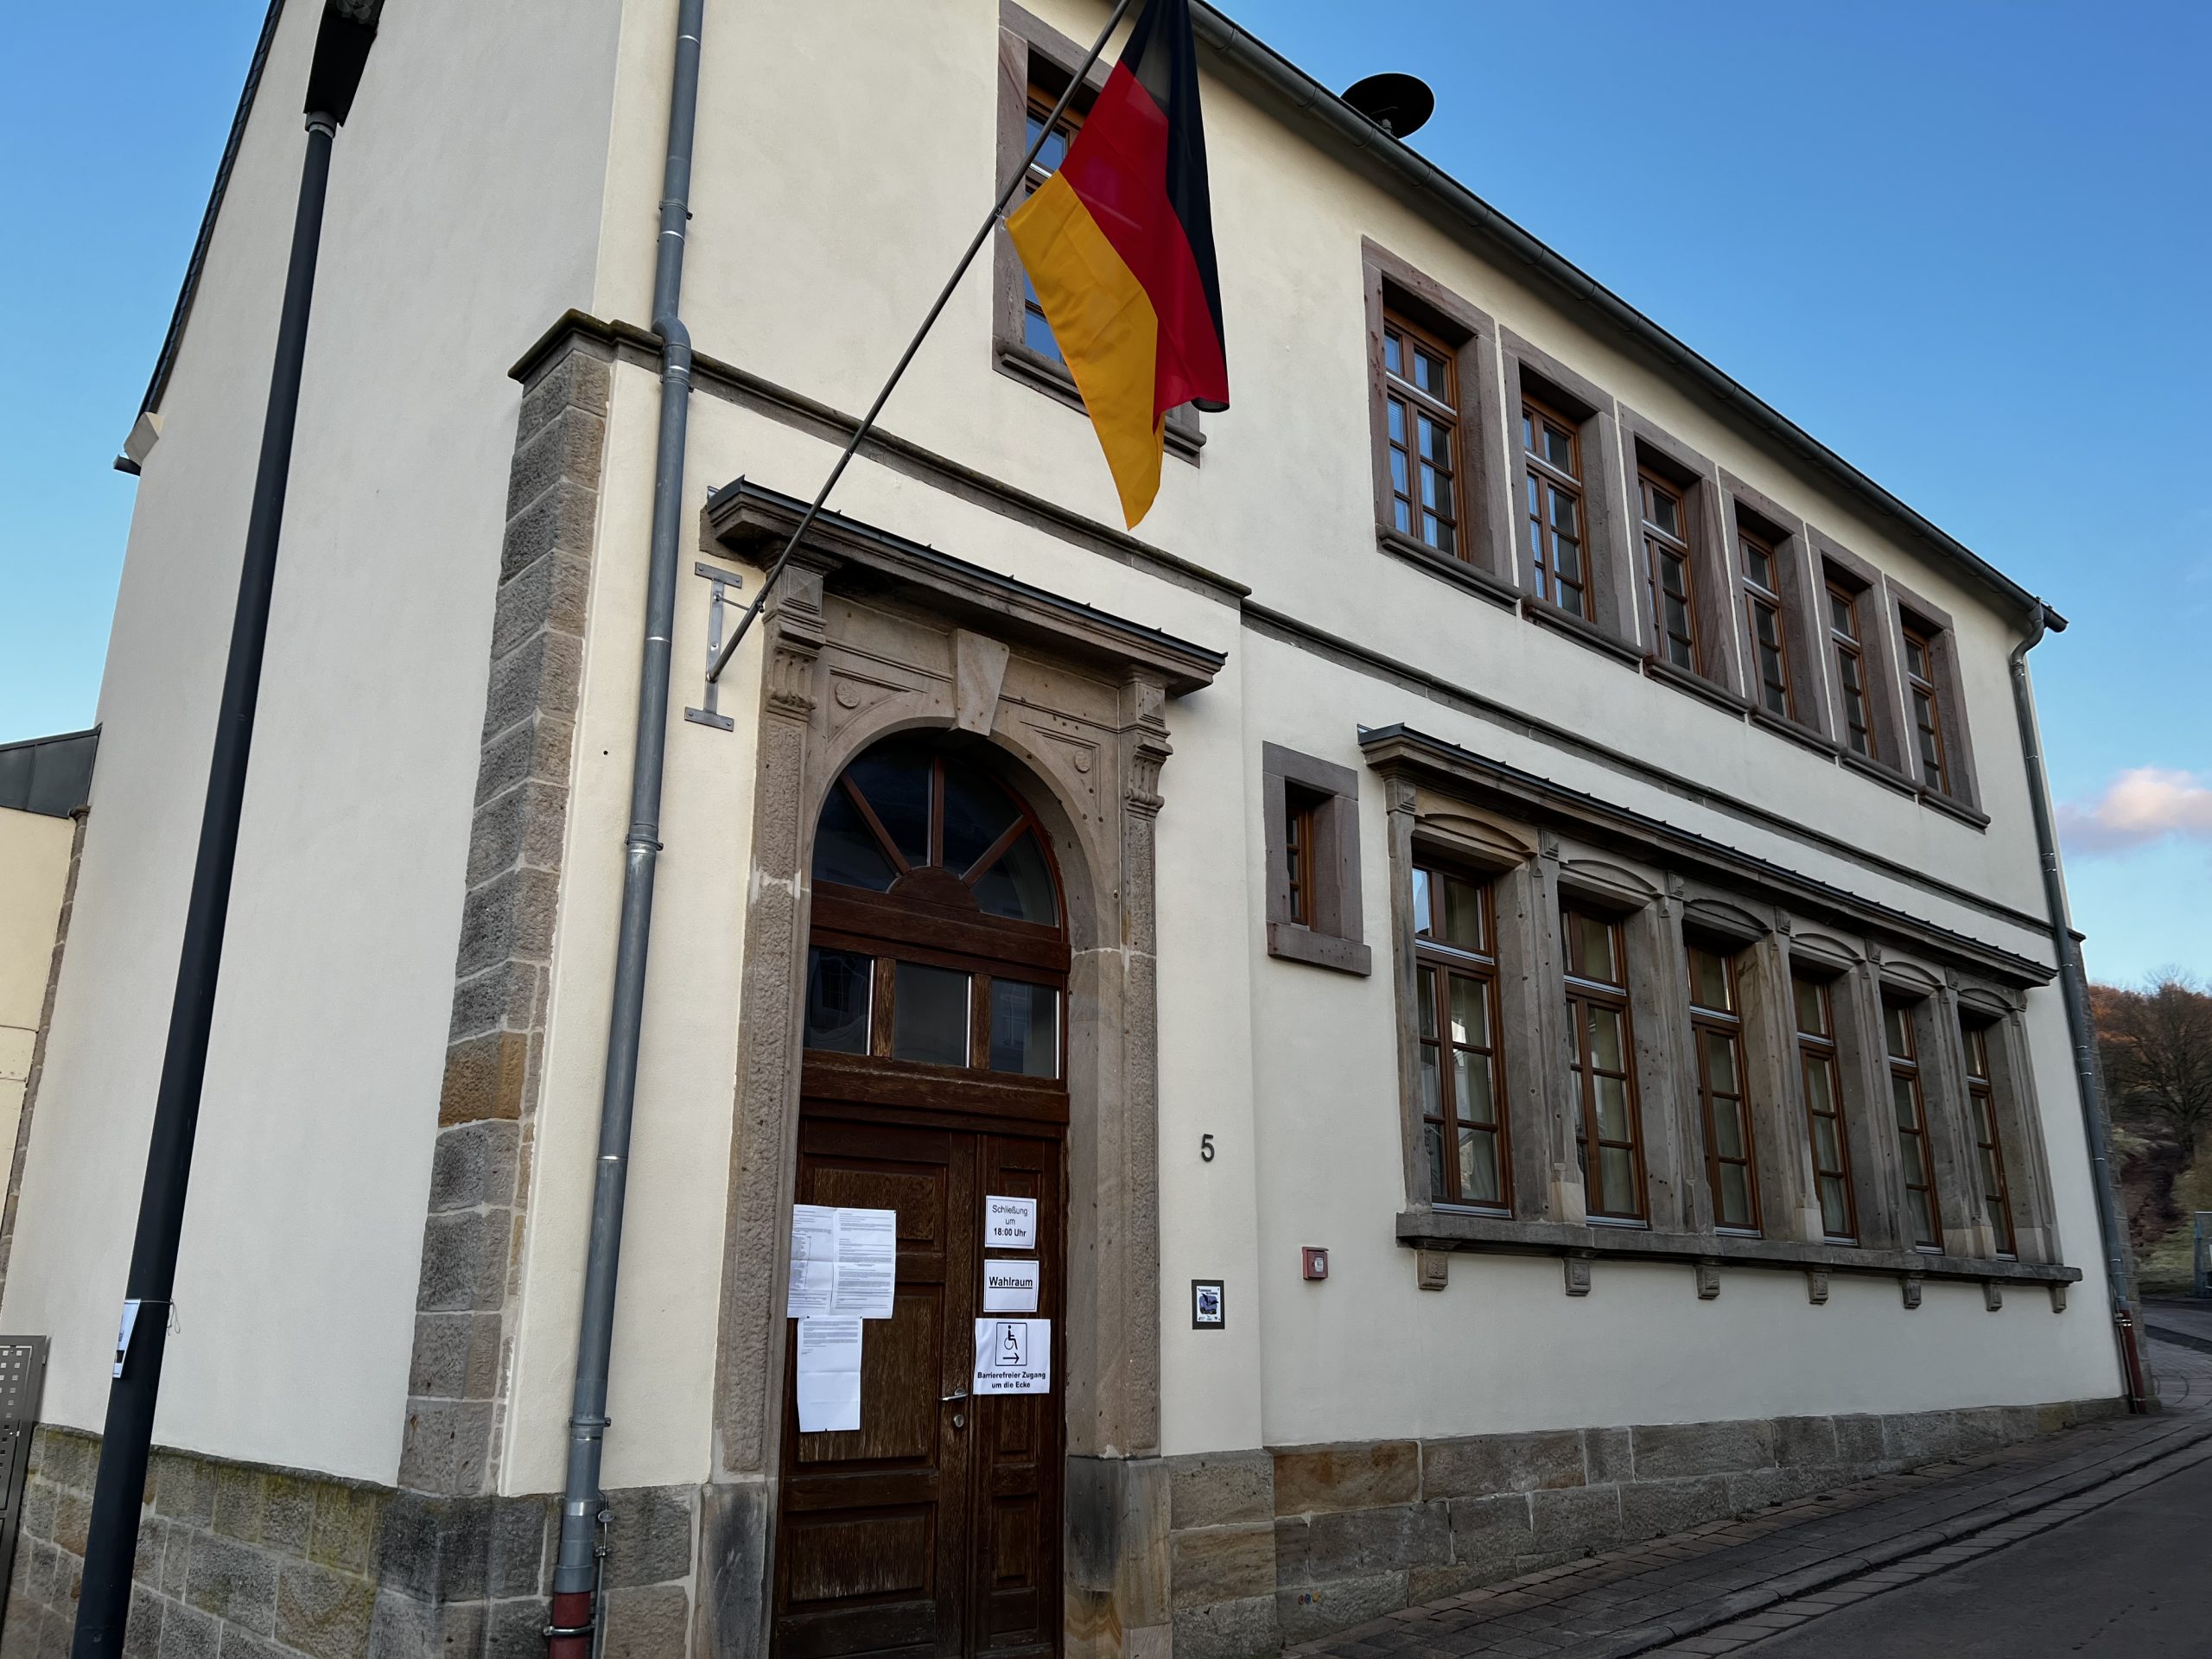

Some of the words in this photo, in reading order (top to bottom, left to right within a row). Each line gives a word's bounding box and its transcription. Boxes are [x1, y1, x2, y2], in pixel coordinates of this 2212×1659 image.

[1201, 1133, 1215, 1162] 5
[992, 1205, 1028, 1217] Schließung
[994, 1228, 1013, 1236] 18:00
[1014, 1228, 1027, 1237] Uhr
[988, 1276, 1033, 1287] Wahlraum
[1021, 1371, 1046, 1380] Zugang
